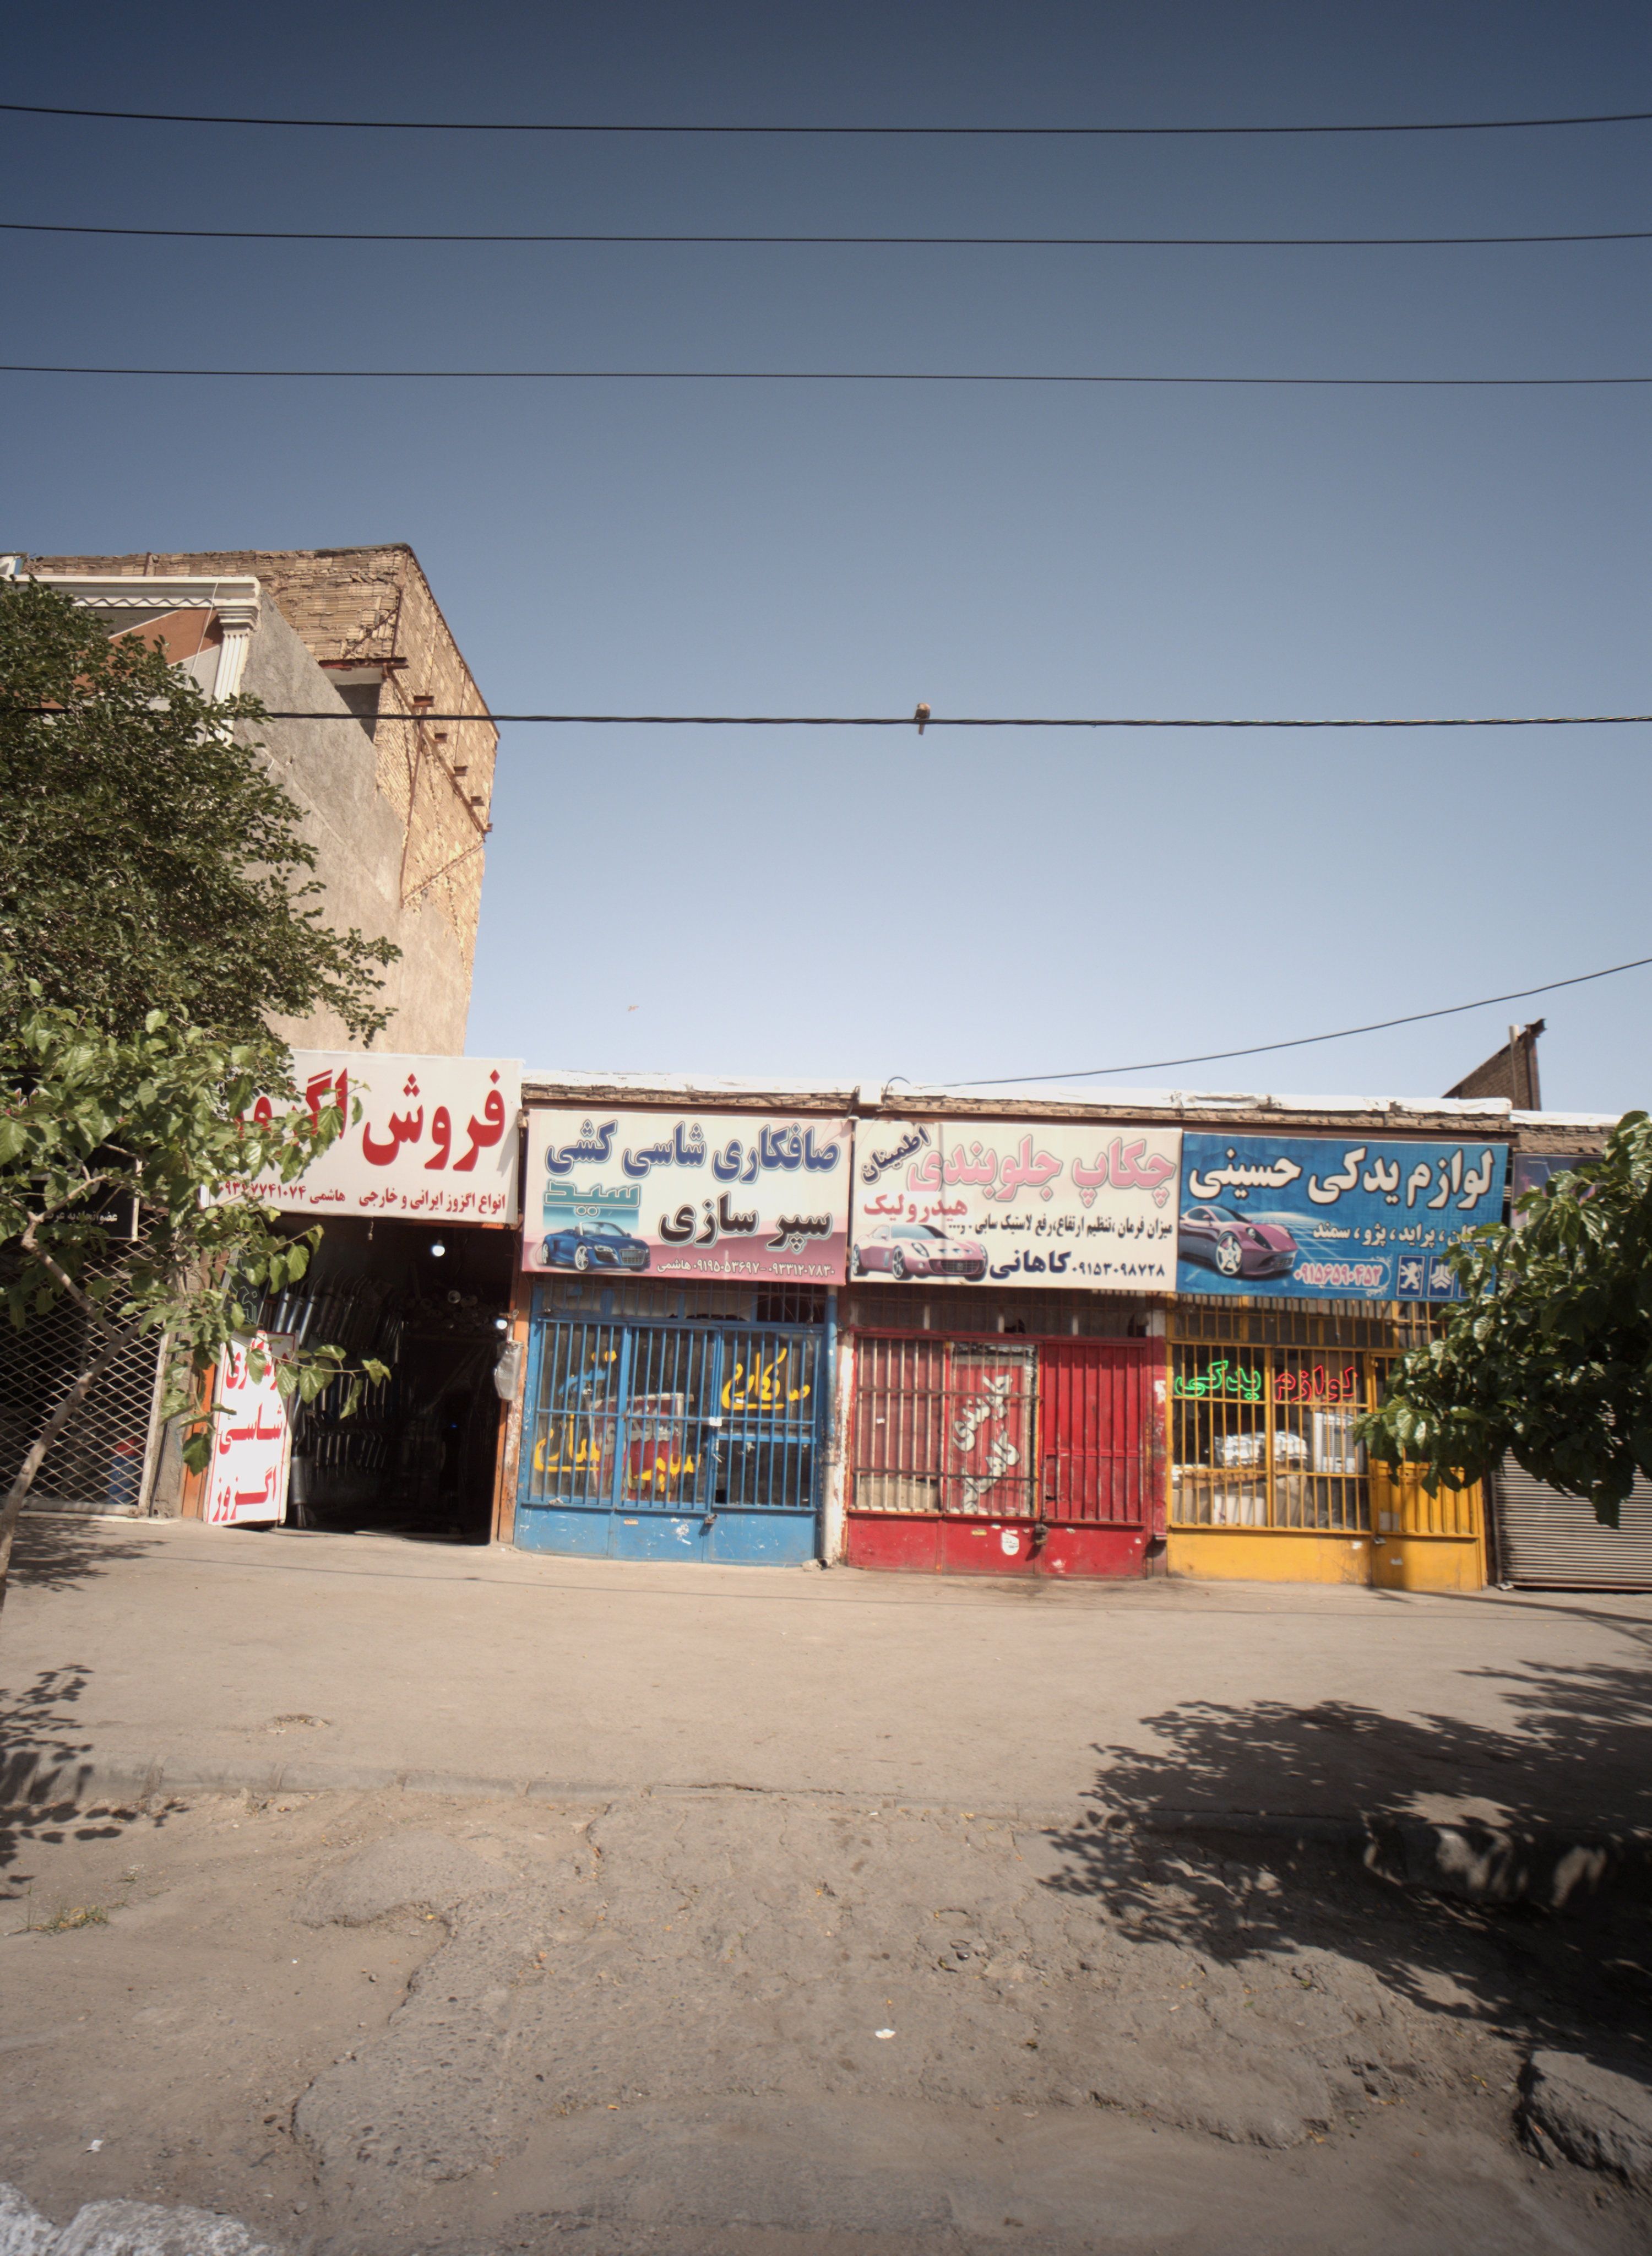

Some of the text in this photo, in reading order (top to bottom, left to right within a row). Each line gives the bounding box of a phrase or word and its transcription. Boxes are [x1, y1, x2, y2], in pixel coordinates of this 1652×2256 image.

[362, 1070, 506, 1171] فروش
[546, 1119, 840, 1183] صافکاری شاسی کشی
[861, 1125, 931, 1184] اطمینان
[907, 1135, 1177, 1208] چکاپ جلوبندی
[1189, 1146, 1495, 1209] لوازم یدکی حسینی
[309, 1189, 346, 1204] هاشمی
[359, 1187, 398, 1208] خارجی
[401, 1195, 407, 1209] و
[410, 1189, 443, 1211] ایرانی
[446, 1192, 475, 1212] اگزوز
[478, 1194, 506, 1214] انواع
[544, 1180, 641, 1216] سید
[863, 1193, 968, 1223] هیدرولیک
[660, 1192, 832, 1252] سپر سازی
[1117, 1216, 1145, 1239] فرمان
[1147, 1217, 1173, 1239] میزان
[1313, 1222, 1350, 1239] سمند
[1362, 1222, 1386, 1246] پژو
[1399, 1223, 1436, 1248] پراید
[656, 1259, 691, 1272] هاشمی
[990, 1249, 1072, 1279] کاهانی
[1174, 1359, 1358, 1403] لوازم یدکی
[219, 1402, 283, 1455] شاسی
[212, 1465, 277, 1522] اگزوز
